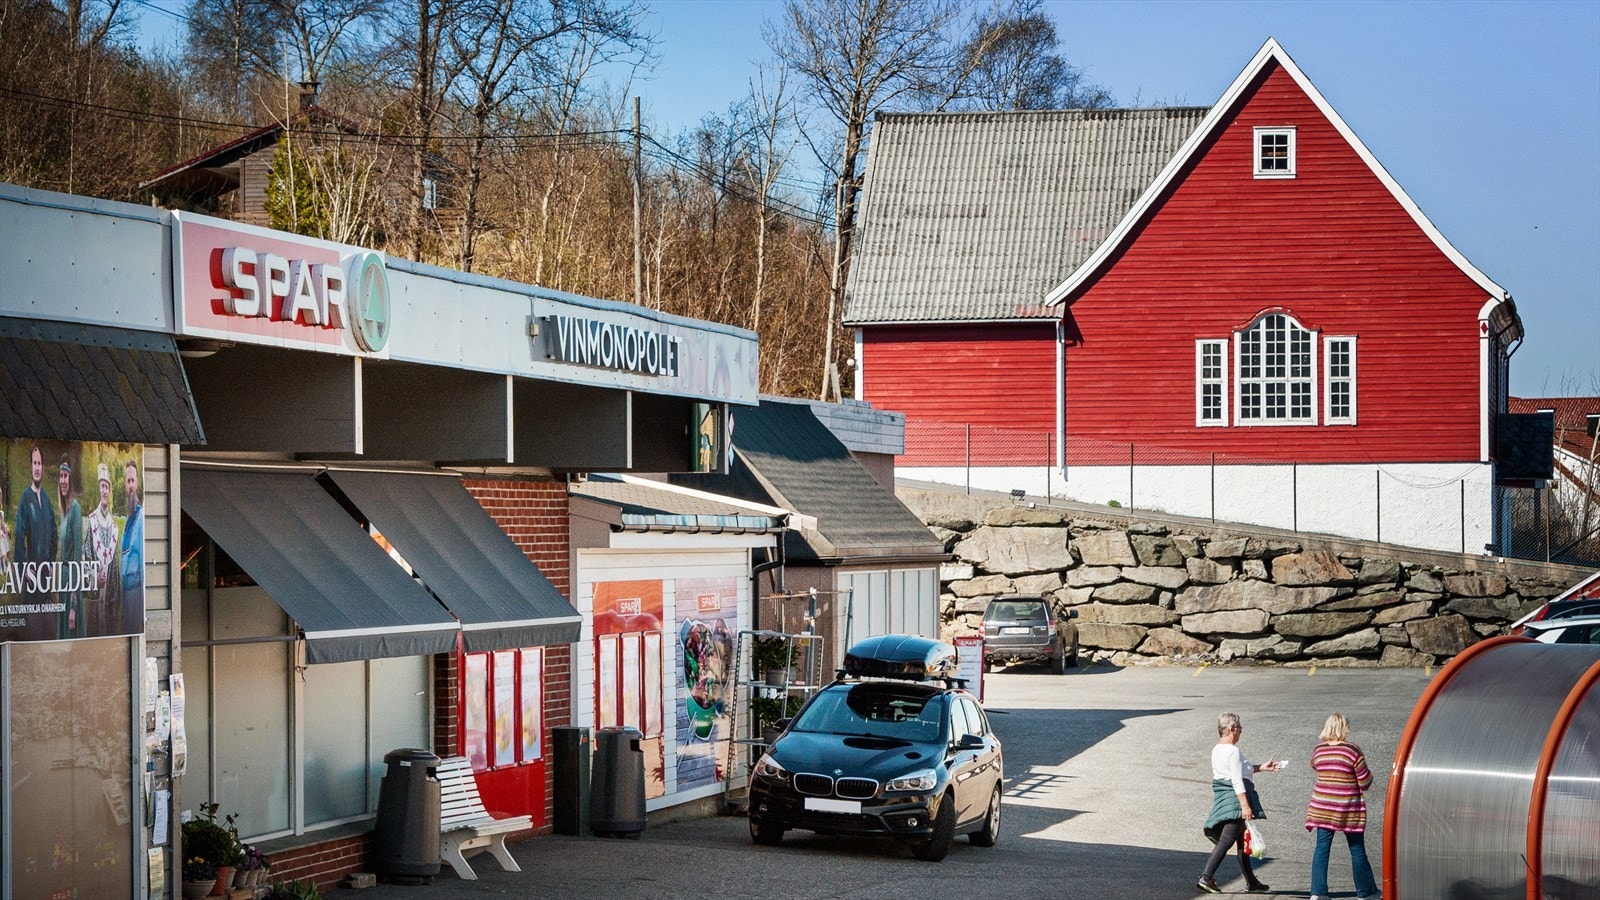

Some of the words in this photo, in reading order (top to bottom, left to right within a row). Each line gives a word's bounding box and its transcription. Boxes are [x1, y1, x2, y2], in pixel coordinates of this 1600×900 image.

[222, 246, 347, 329] SPAR
[557, 314, 683, 377] VINMONOPOLET
[620, 602, 635, 613] SPAR
[701, 597, 715, 608] SPAR
